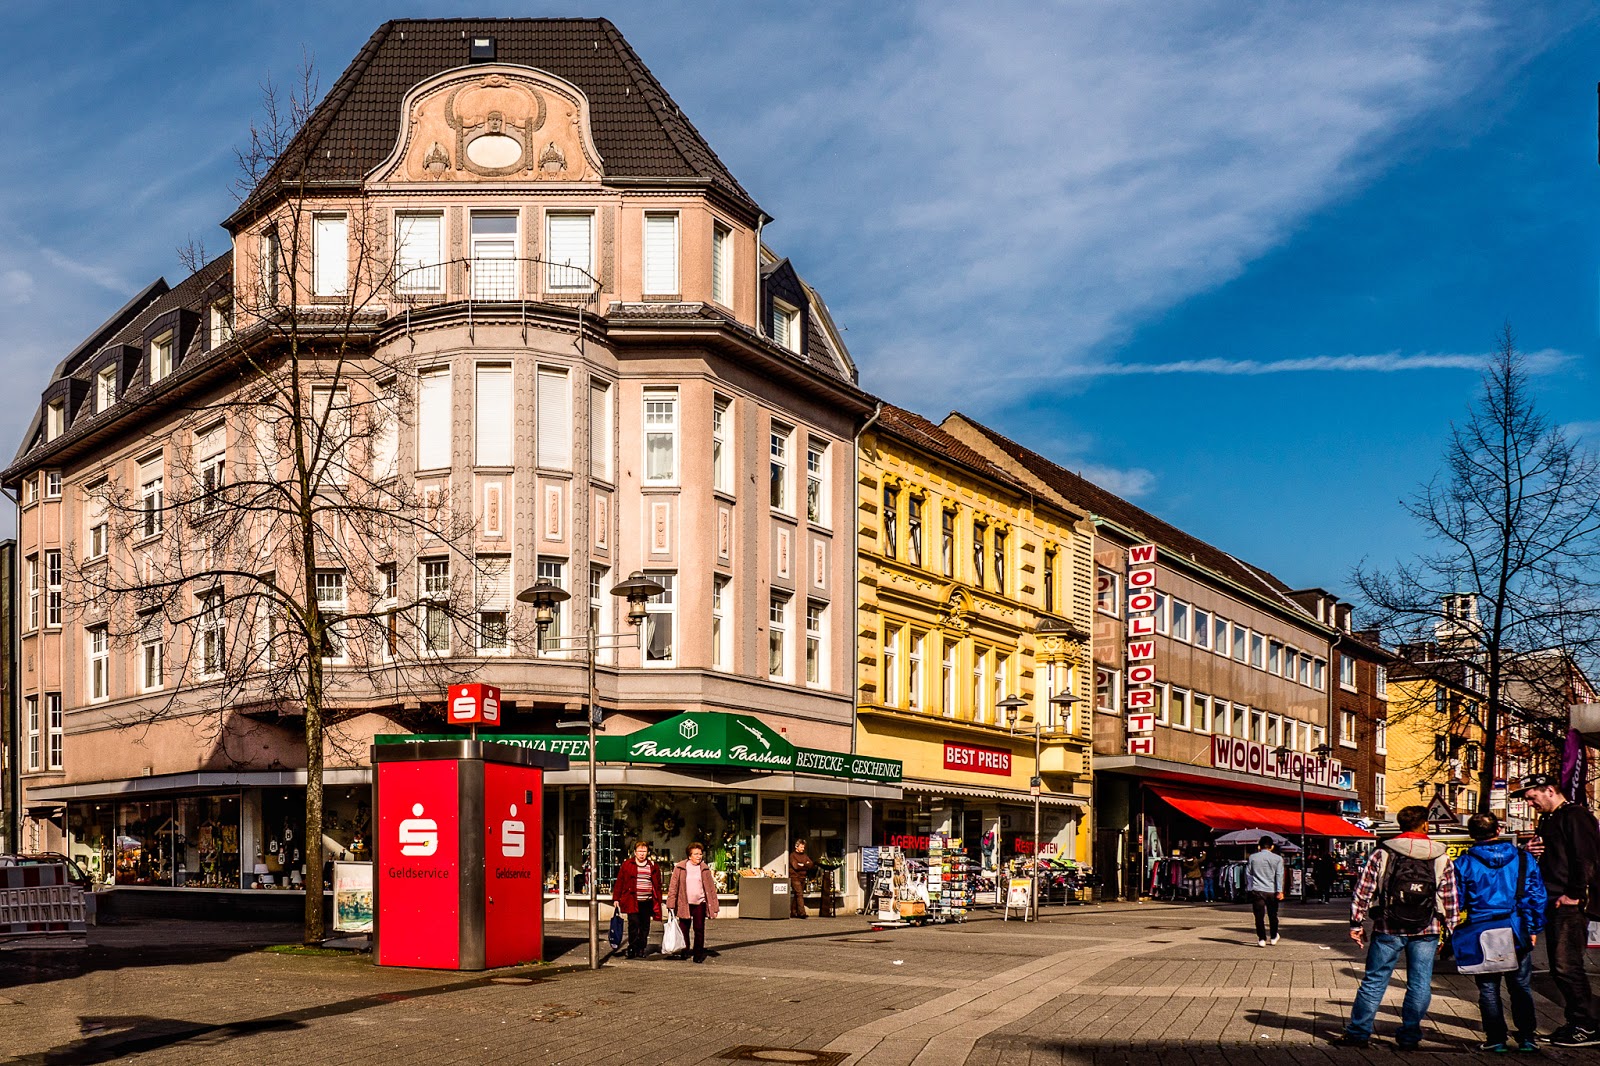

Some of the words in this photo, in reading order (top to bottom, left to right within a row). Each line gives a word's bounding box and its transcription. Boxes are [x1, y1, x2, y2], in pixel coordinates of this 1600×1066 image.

[1130, 546, 1154, 754] WOOLWORTH
[629, 741, 721, 758] Paashaus
[729, 745, 792, 766] Paashaus
[946, 746, 975, 765] BEST
[978, 751, 1009, 770] PREIS
[796, 751, 843, 772] BESTECKE
[851, 759, 901, 778] GESCHENKE
[1015, 838, 1058, 854] RESTOSTEN
[389, 867, 449, 879] Geldservice
[496, 867, 531, 879] Geldservice
